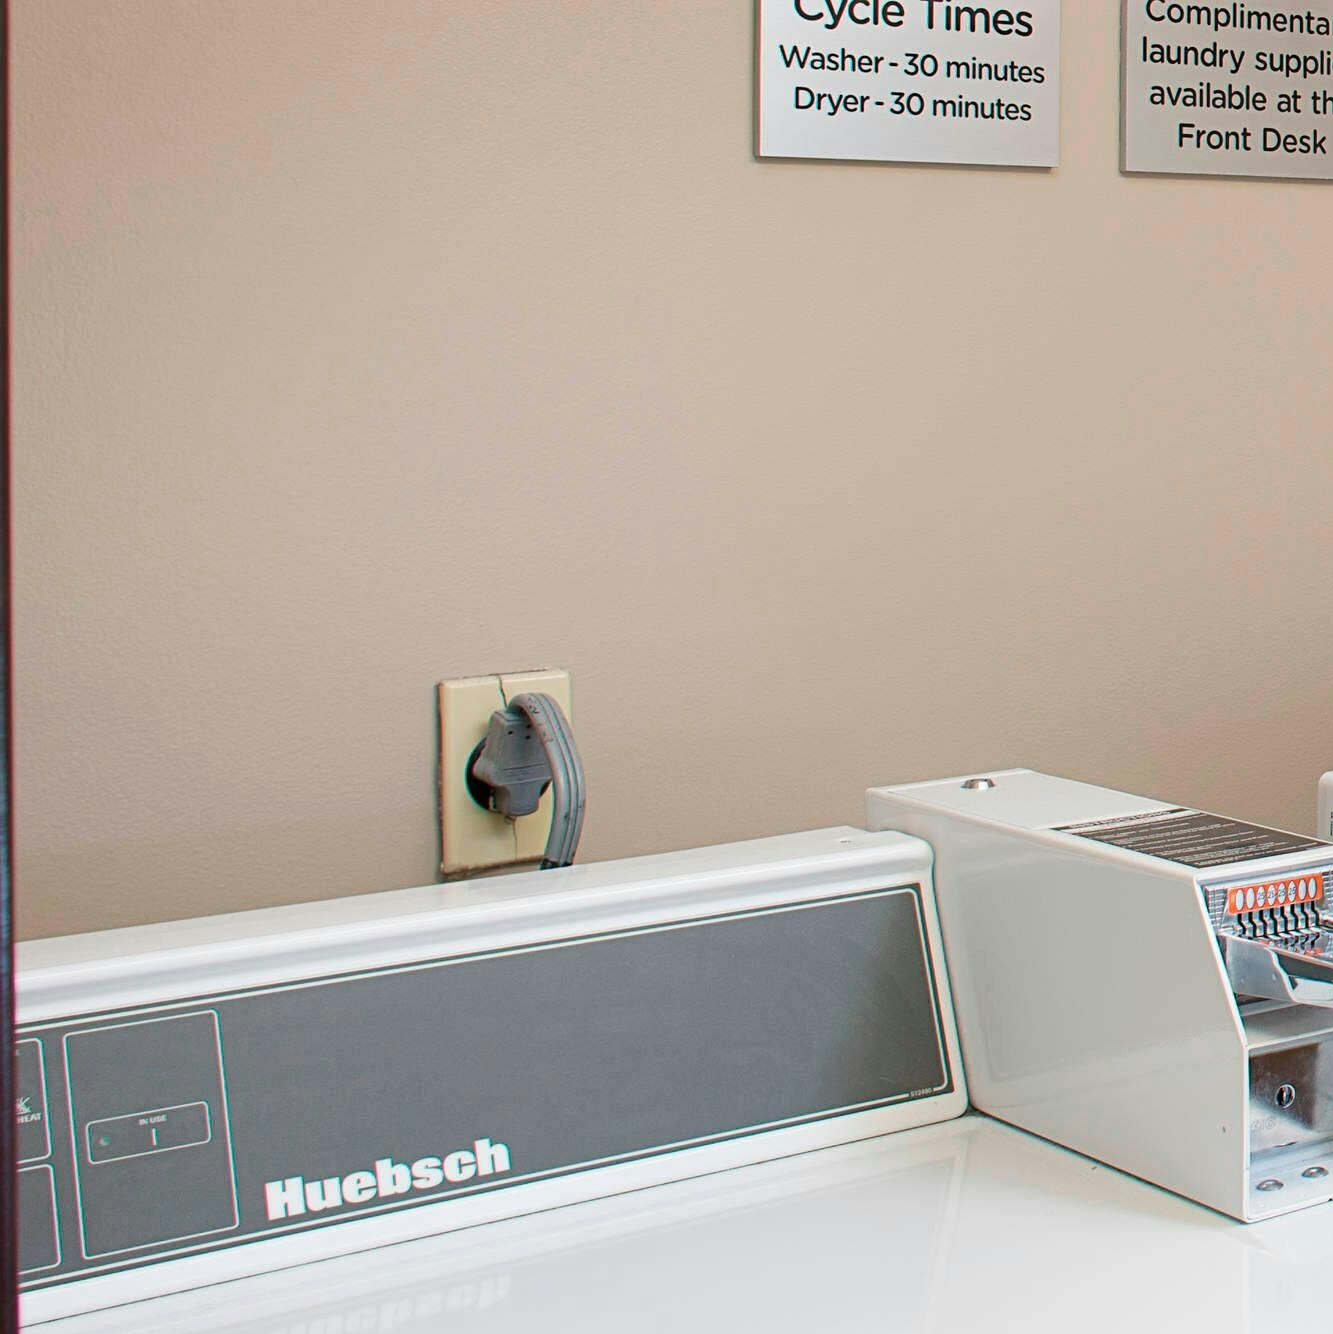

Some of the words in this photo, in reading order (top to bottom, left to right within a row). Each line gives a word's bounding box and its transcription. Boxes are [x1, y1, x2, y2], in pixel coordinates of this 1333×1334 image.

[794, 0, 905, 30] Cycle
[922, 0, 1033, 36] Times
[779, 44, 884, 73] Washer
[904, 53, 938, 77] 30
[946, 56, 1045, 84] minutes
[1142, 36, 1245, 74] laundry
[794, 86, 870, 116] Dryer
[890, 91, 925, 116] 30
[932, 95, 1032, 121] minutes
[1150, 82, 1267, 111] available
[1277, 90, 1301, 114] at
[1178, 123, 1252, 151] Front
[1263, 127, 1327, 154] Desk
[149, 1114, 167, 1124] USE
[264, 1137, 512, 1221] Huebsch
